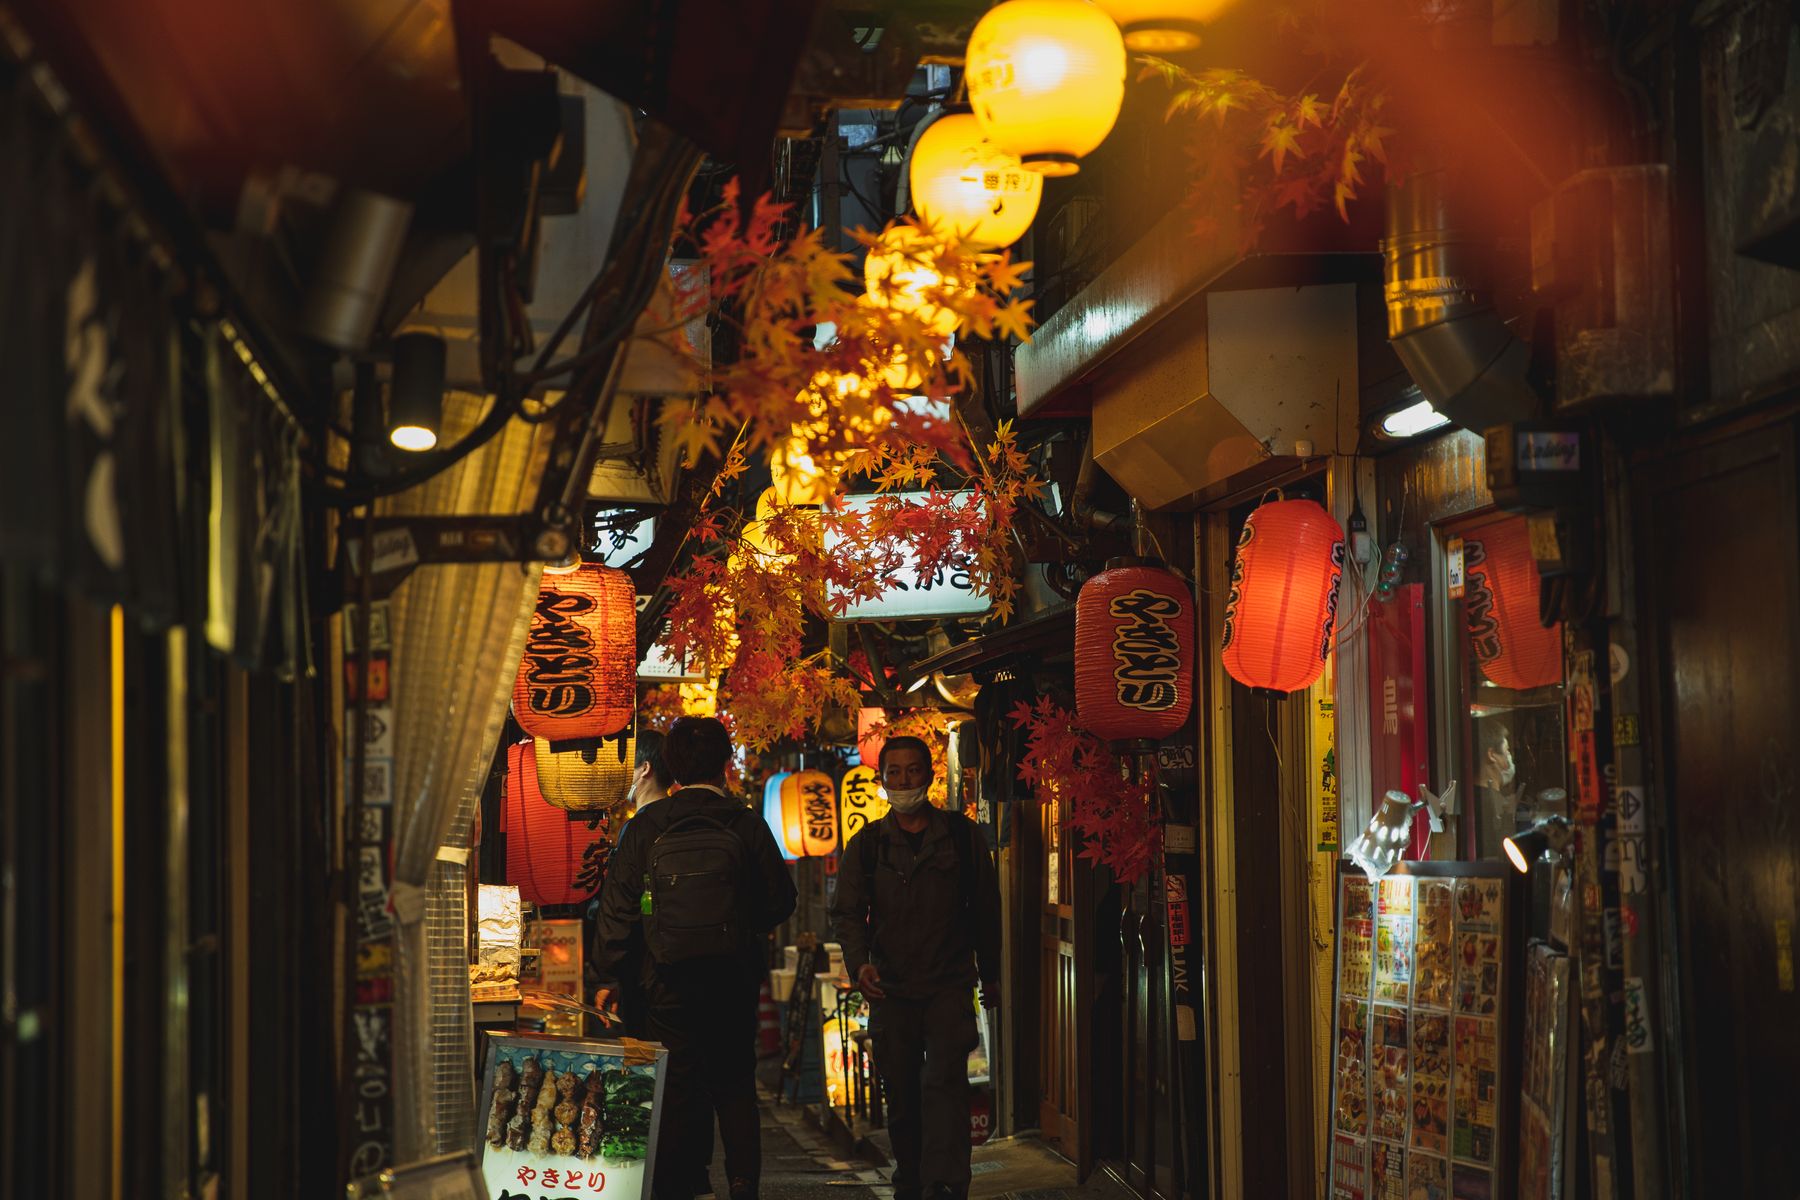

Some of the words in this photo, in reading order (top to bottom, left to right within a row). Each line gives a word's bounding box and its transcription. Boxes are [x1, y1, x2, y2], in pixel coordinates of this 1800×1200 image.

[959, 171, 1034, 191] 一番搾り
[1110, 590, 1182, 711] やきとり
[516, 1165, 606, 1193] やきとり
